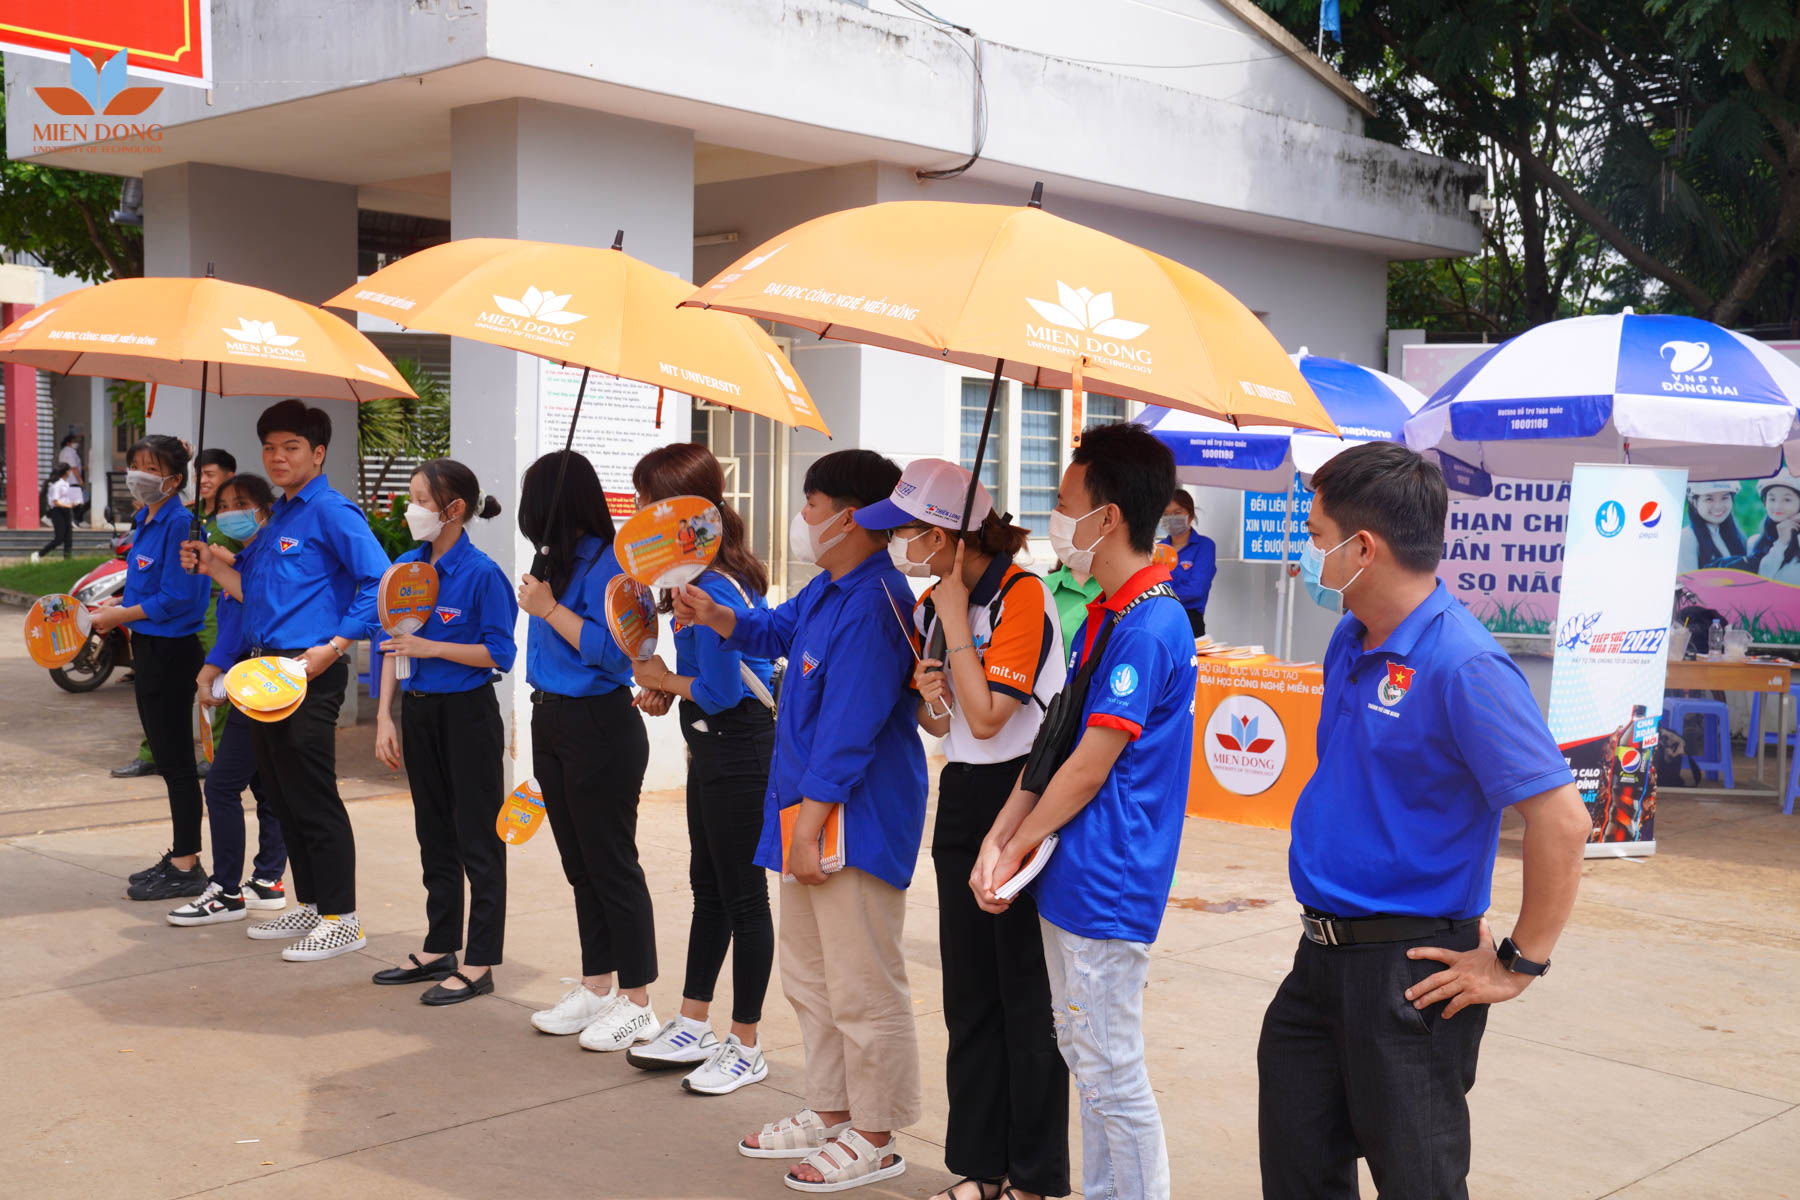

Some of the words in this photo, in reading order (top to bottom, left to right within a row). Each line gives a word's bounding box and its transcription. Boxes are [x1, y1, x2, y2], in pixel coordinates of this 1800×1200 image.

[477, 311, 522, 329] MIEN
[523, 321, 577, 341] DONG
[226, 341, 260, 353] MIEN
[263, 345, 305, 358] DONG
[1026, 323, 1079, 349] MIEN
[1086, 336, 1153, 365] DONG
[1027, 340, 1077, 357] UNIVERSITY
[1093, 355, 1153, 375] TECHNOLOGY
[658, 361, 679, 377] MIT
[680, 368, 741, 397] UNIVERSITY
[1711, 385, 1739, 396] NAI
[1337, 424, 1392, 439] inaphone
[1250, 494, 1267, 512] ĐẾN
[1246, 518, 1259, 532] XIN
[1261, 519, 1275, 533] VUI
[1451, 512, 1512, 535] HẠN
[1523, 514, 1568, 533] CH
[1501, 543, 1565, 563] THƯ
[1457, 572, 1496, 596] SỌ
[1621, 629, 1665, 652] 2022
[990, 665, 1027, 683] mit.vn
[1200, 675, 1215, 687] ĐẠI
[1233, 677, 1258, 689] CÔNG
[1260, 680, 1285, 693] NGHỆ
[1311, 683, 1324, 695] ĐÔ
[1213, 752, 1239, 765] MIEN
[1241, 756, 1274, 770] DONG
[1579, 768, 1600, 778] CALO
[612, 1013, 651, 1043] BOSTON
